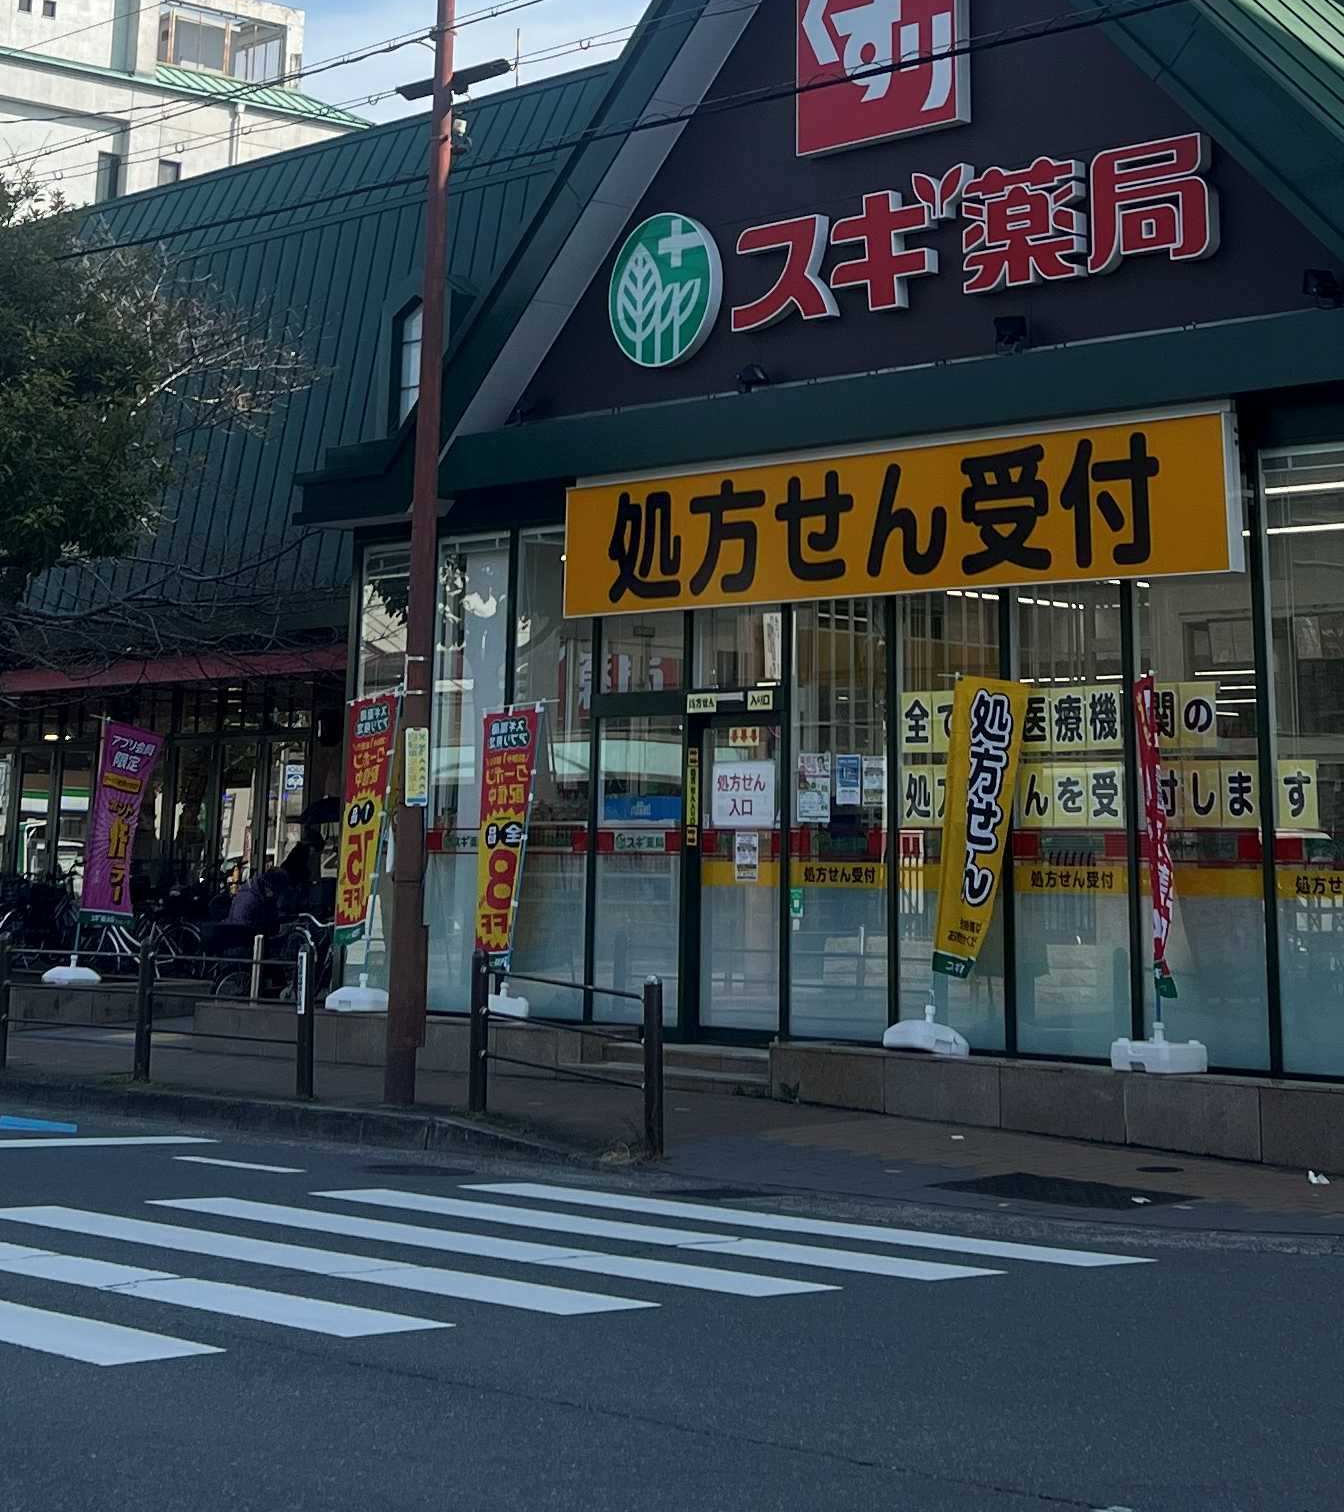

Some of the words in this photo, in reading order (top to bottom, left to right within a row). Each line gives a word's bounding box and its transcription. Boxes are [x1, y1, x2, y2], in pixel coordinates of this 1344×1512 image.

[731, 132, 1220, 333] スギ薬局
[608, 432, 1160, 603] 処方せん受付
[112, 751, 141, 773] 限定
[717, 774, 766, 792] 処方せん
[729, 798, 753, 817] 入口
[804, 866, 876, 884] 処方せん受付
[1031, 870, 1114, 889] 処方せん受付
